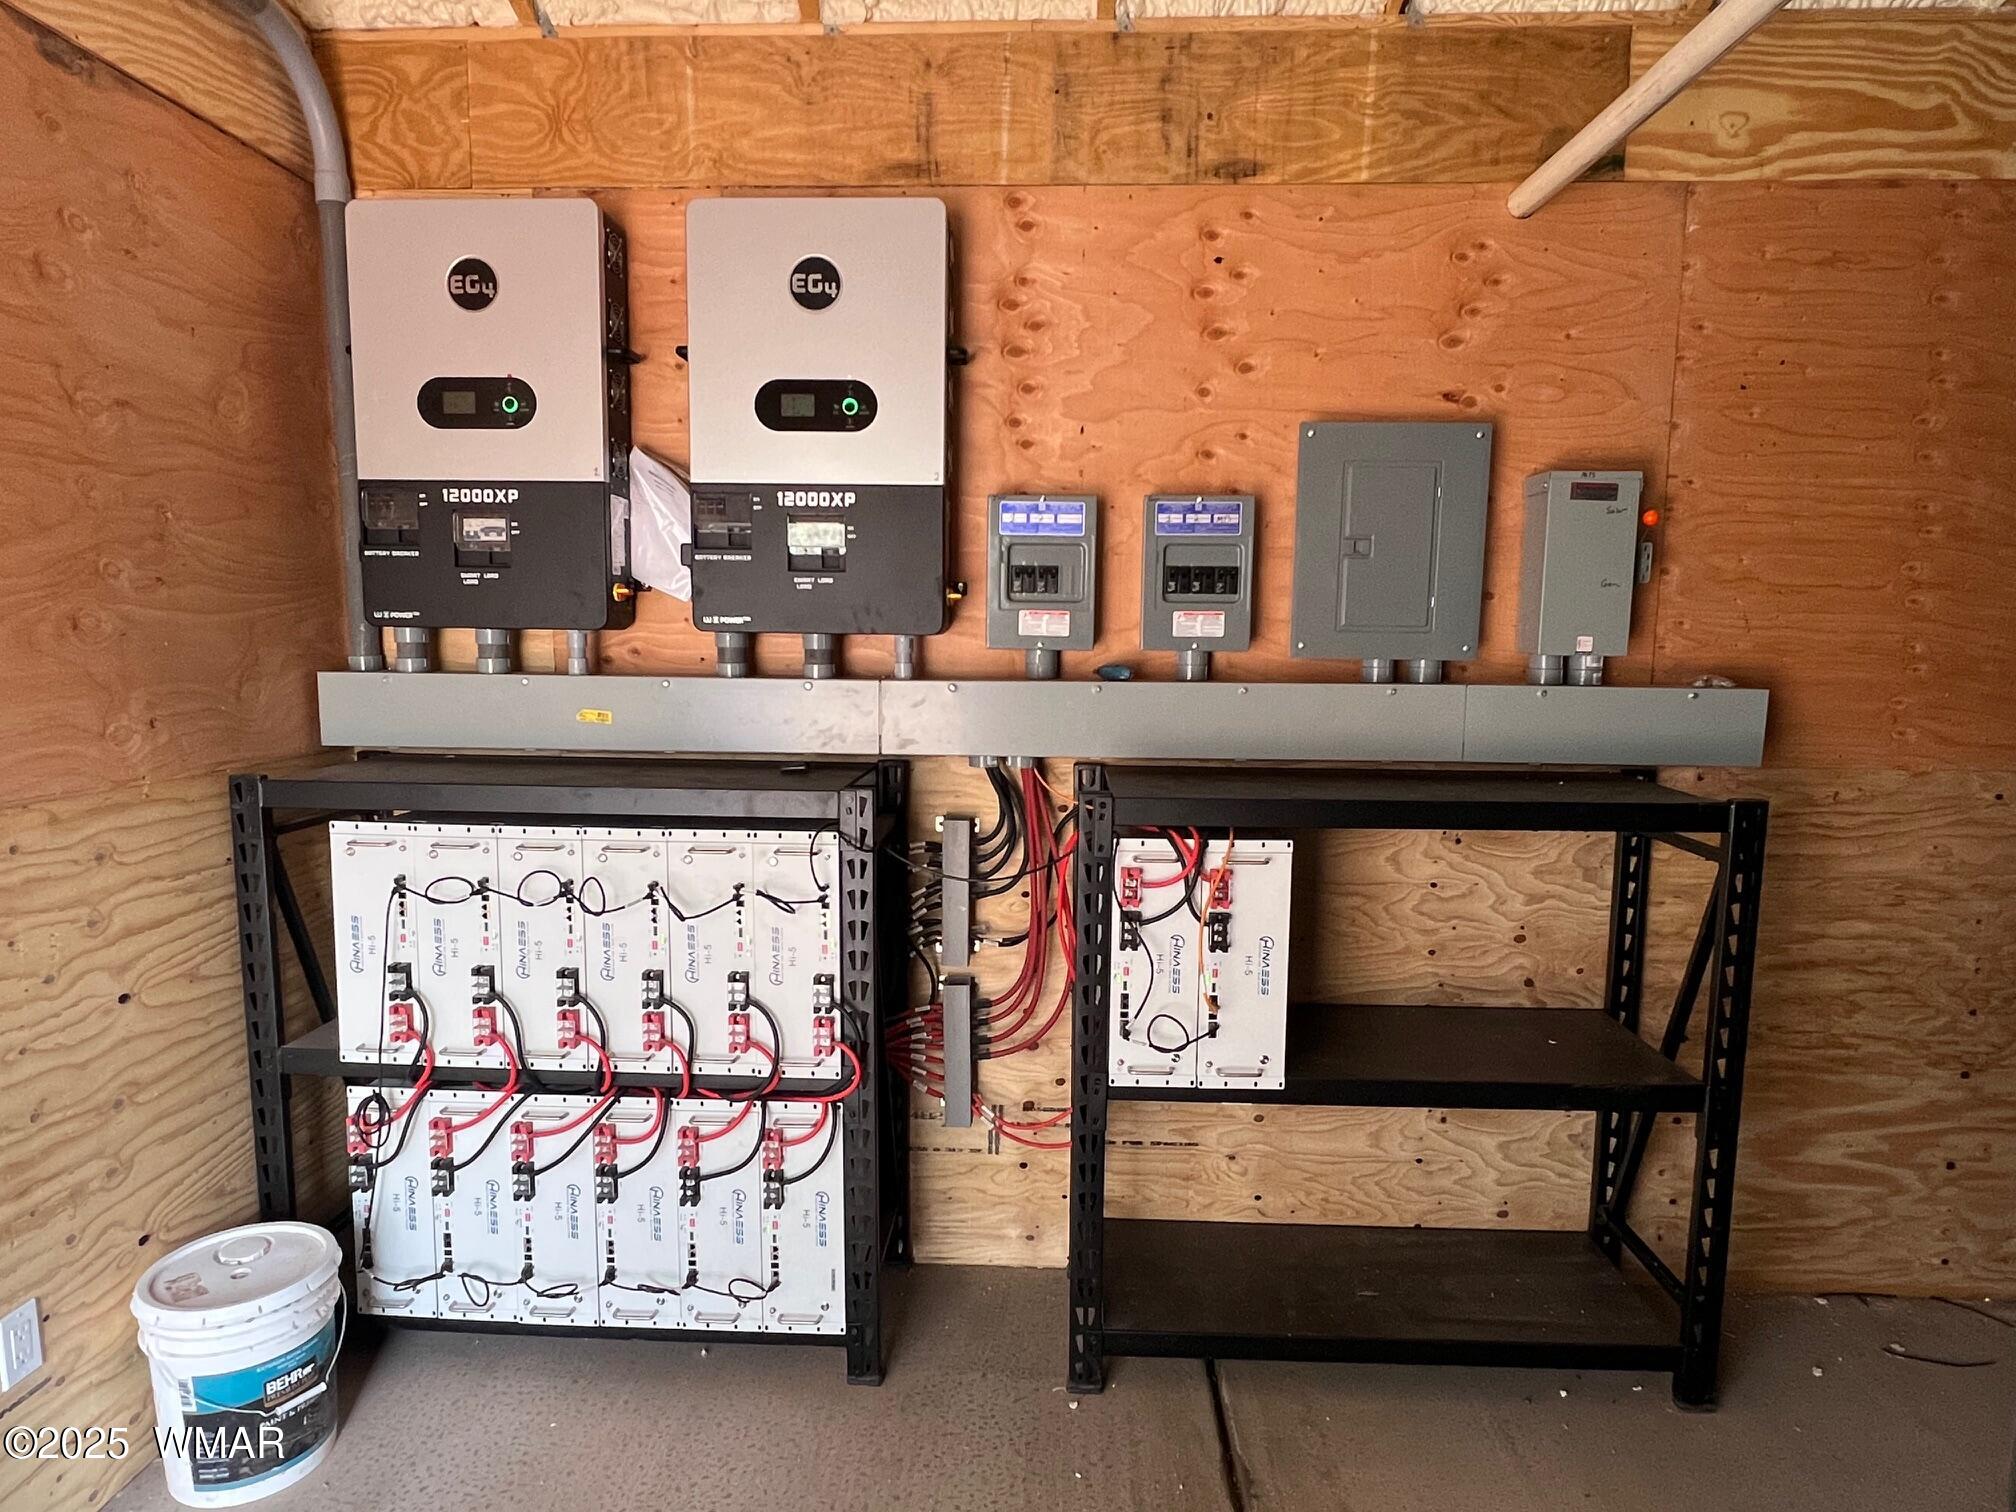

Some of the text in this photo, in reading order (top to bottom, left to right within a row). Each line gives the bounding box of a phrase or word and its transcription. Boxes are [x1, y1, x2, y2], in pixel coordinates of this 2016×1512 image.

[450, 274, 496, 298] EG4
[792, 273, 838, 298] EG4
[442, 488, 519, 503] 12000XP
[776, 491, 856, 507] 12000XP
[265, 1367, 303, 1396] BEHR
